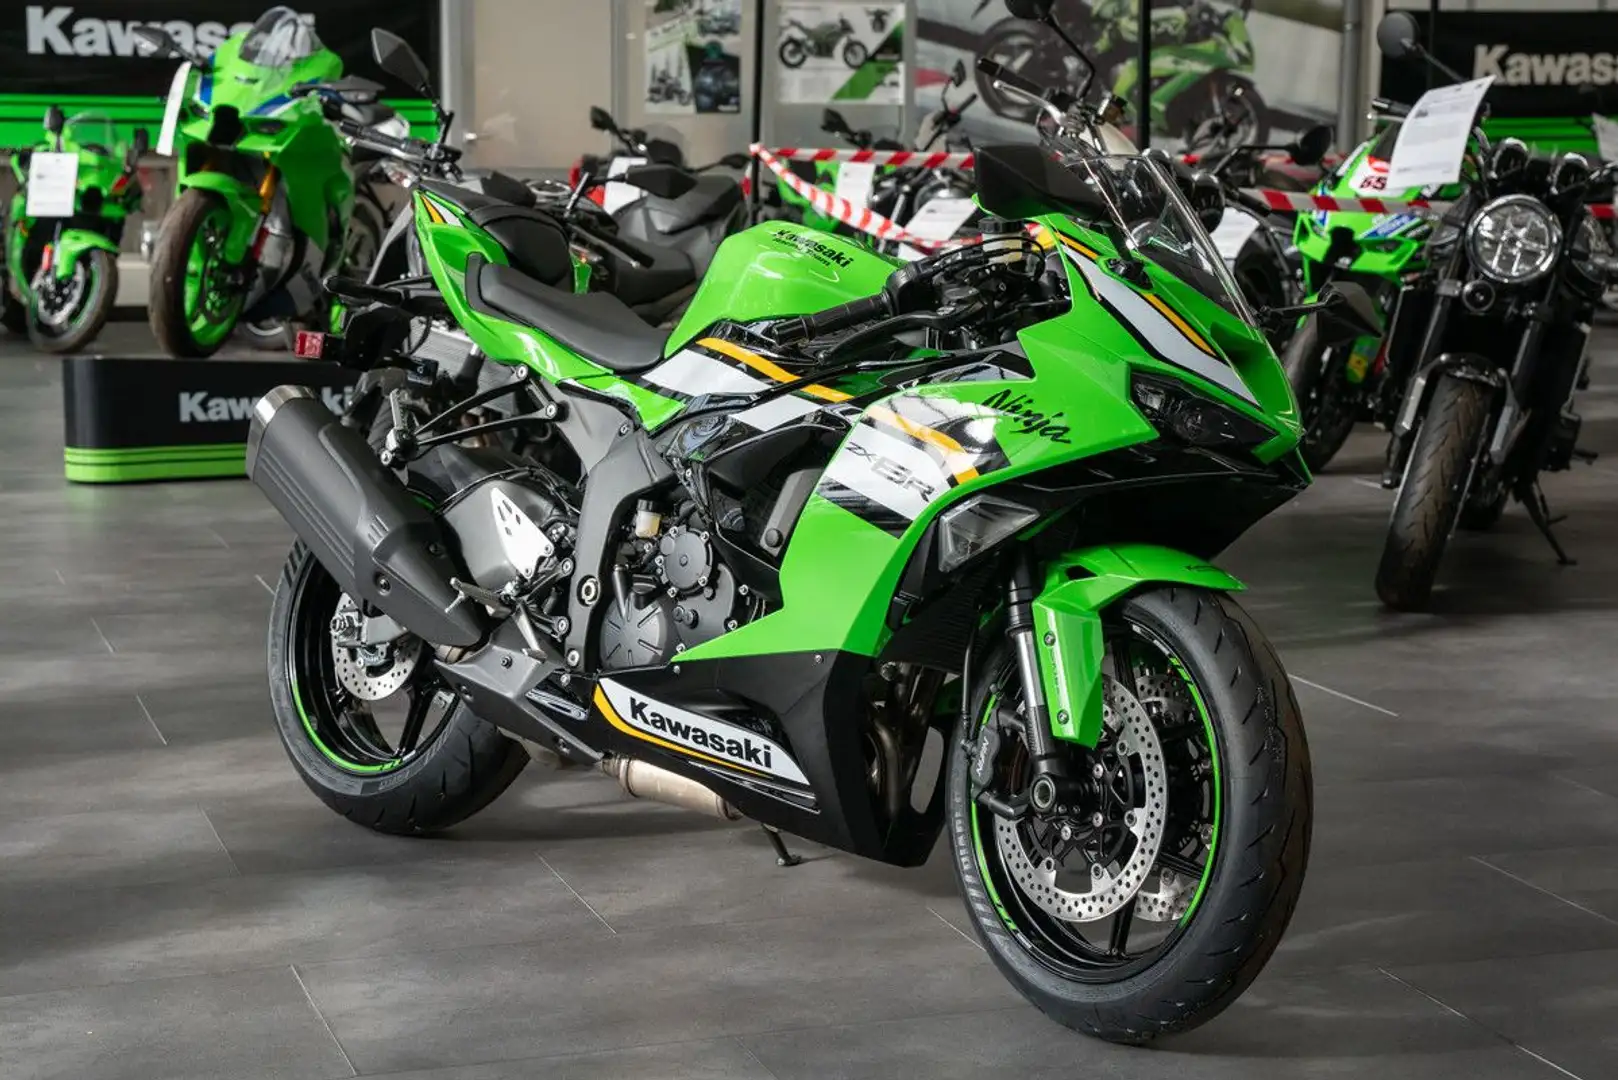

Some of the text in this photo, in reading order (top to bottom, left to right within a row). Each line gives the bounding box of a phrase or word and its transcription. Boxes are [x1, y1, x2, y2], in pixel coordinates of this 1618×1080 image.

[1473, 44, 1618, 86] Kawas
[773, 230, 854, 268] Kawasaki
[179, 385, 353, 422] Kawki
[980, 389, 1072, 444] Ninja
[629, 697, 773, 769] Kawasaki
